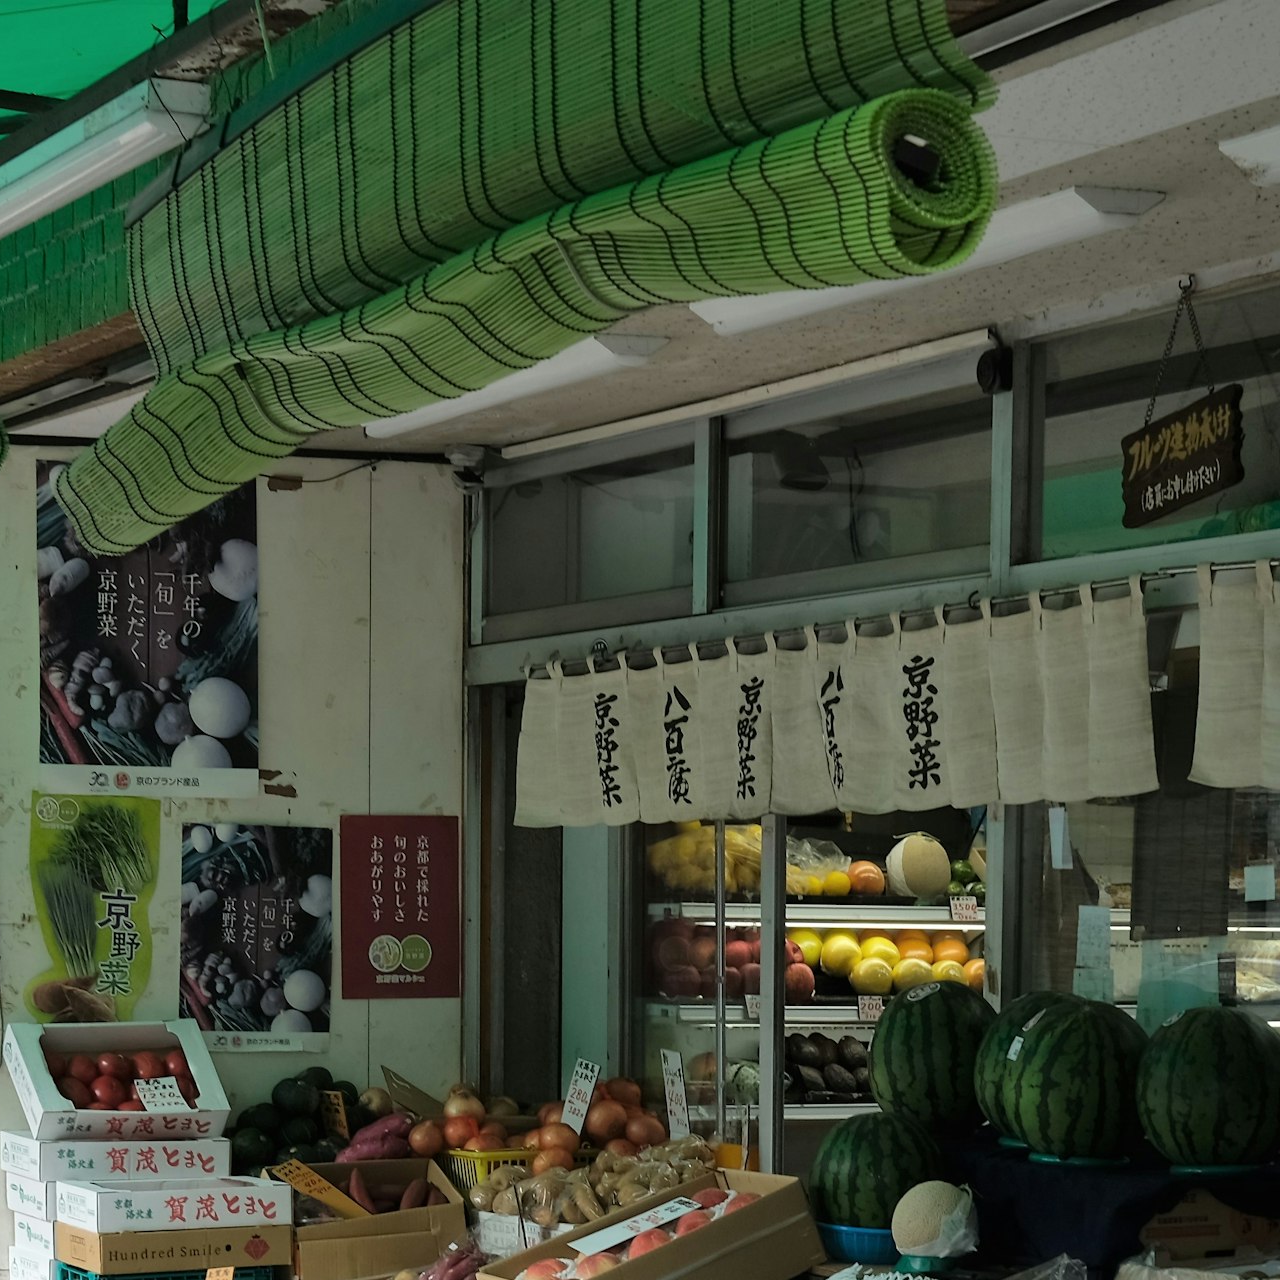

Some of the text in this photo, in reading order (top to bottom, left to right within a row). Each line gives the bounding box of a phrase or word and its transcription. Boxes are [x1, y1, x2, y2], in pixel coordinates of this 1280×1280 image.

[96, 568, 118, 638] 京野菜
[154, 571, 175, 649] 「旬」を
[183, 573, 203, 639] 千年の
[594, 693, 622, 808] 京野菜
[737, 676, 764, 801] 京野菜
[902, 656, 941, 790] 京野菜
[136, 777, 200, 787] 京のブランド産品
[369, 835, 384, 923] おあがりやす
[393, 835, 407, 923] 旬のおいしさ
[416, 835, 429, 923] 京都で採れた
[95, 889, 143, 997] 京野菜
[221, 897, 237, 944] 京野菜
[261, 897, 276, 952] 「旬」を
[281, 897, 294, 944] 千年の
[57, 1149, 75, 1159] 京都
[106, 1115, 212, 1136] 賀茂とまと
[106, 1146, 215, 1174] 賀茂とまと
[115, 1198, 133, 1210] 京都
[165, 1192, 277, 1223] 賀茂とまと
[109, 1243, 222, 1262] Hundred Smile
